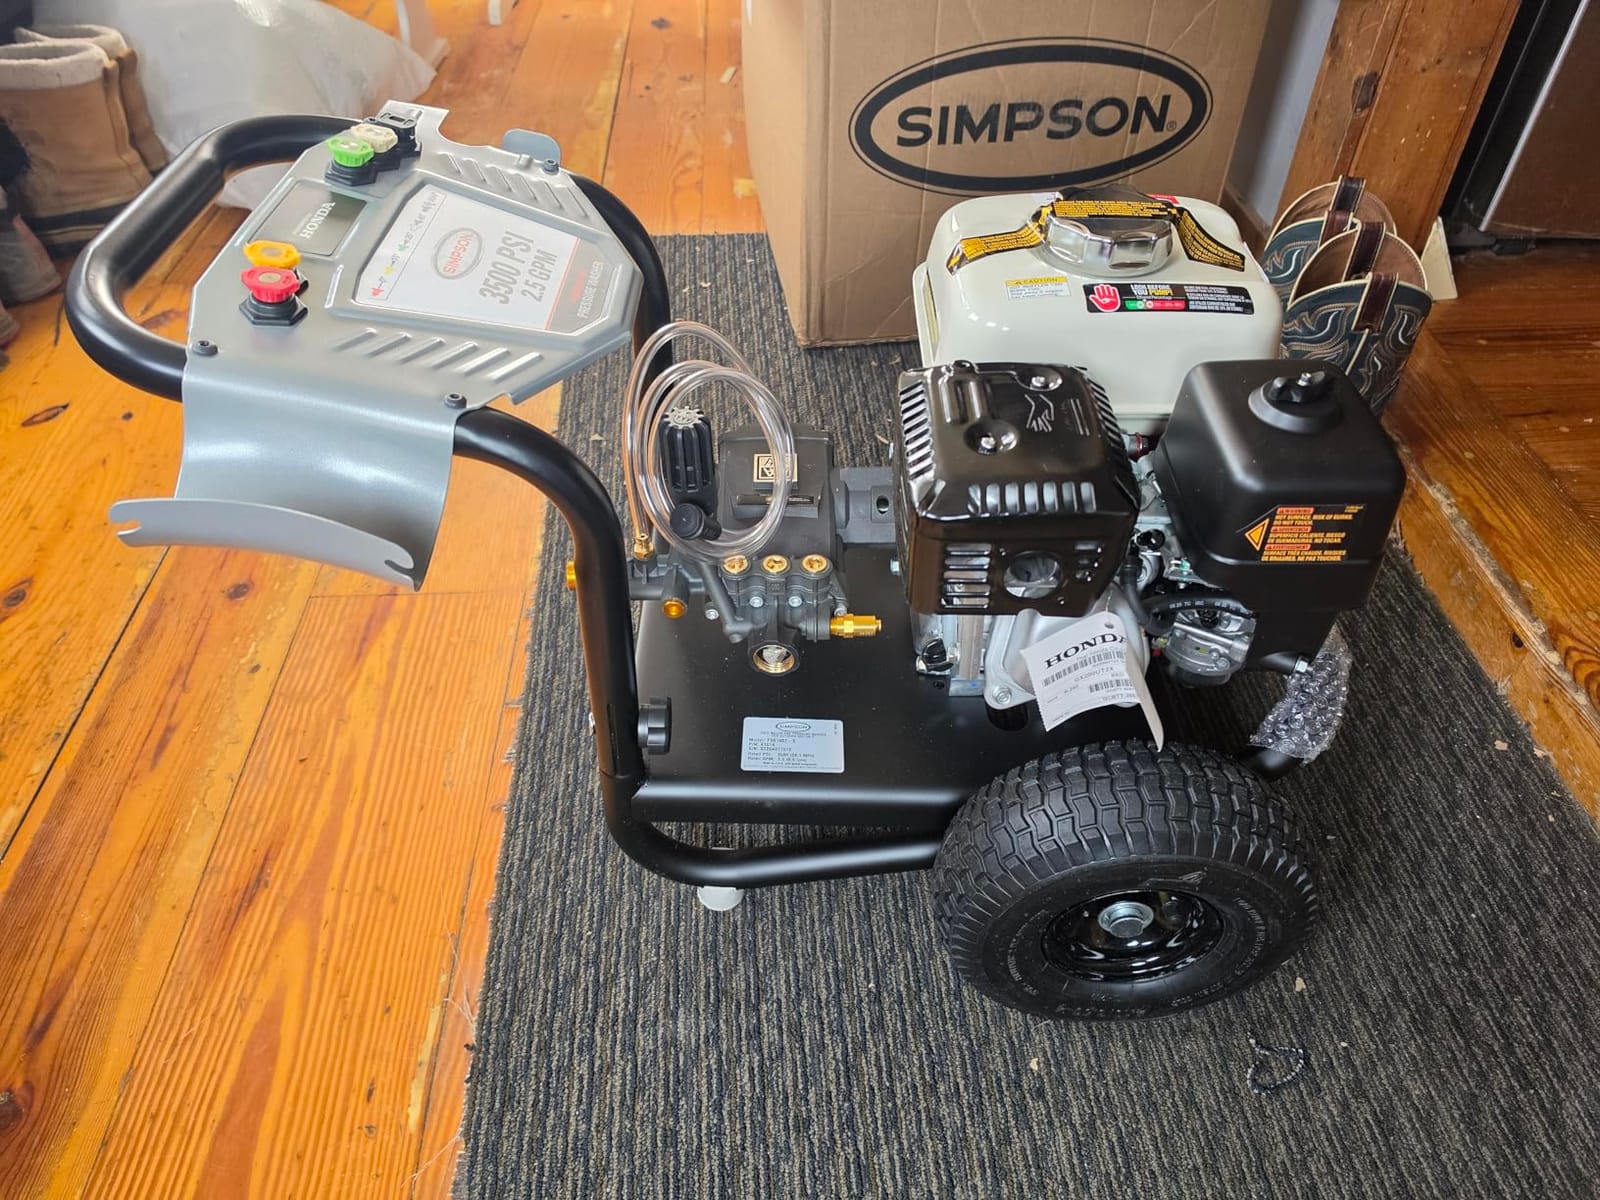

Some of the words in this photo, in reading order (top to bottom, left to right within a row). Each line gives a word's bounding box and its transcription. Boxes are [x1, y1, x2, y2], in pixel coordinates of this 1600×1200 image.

[897, 94, 1172, 147] SIMPSON
[299, 202, 336, 239] HONDA
[443, 232, 475, 274] SIMPSON
[495, 230, 535, 264] PSI
[478, 260, 521, 305] 3500
[527, 249, 558, 281] GPM
[520, 279, 547, 303] 2.5
[1149, 288, 1174, 296] PUMP!
